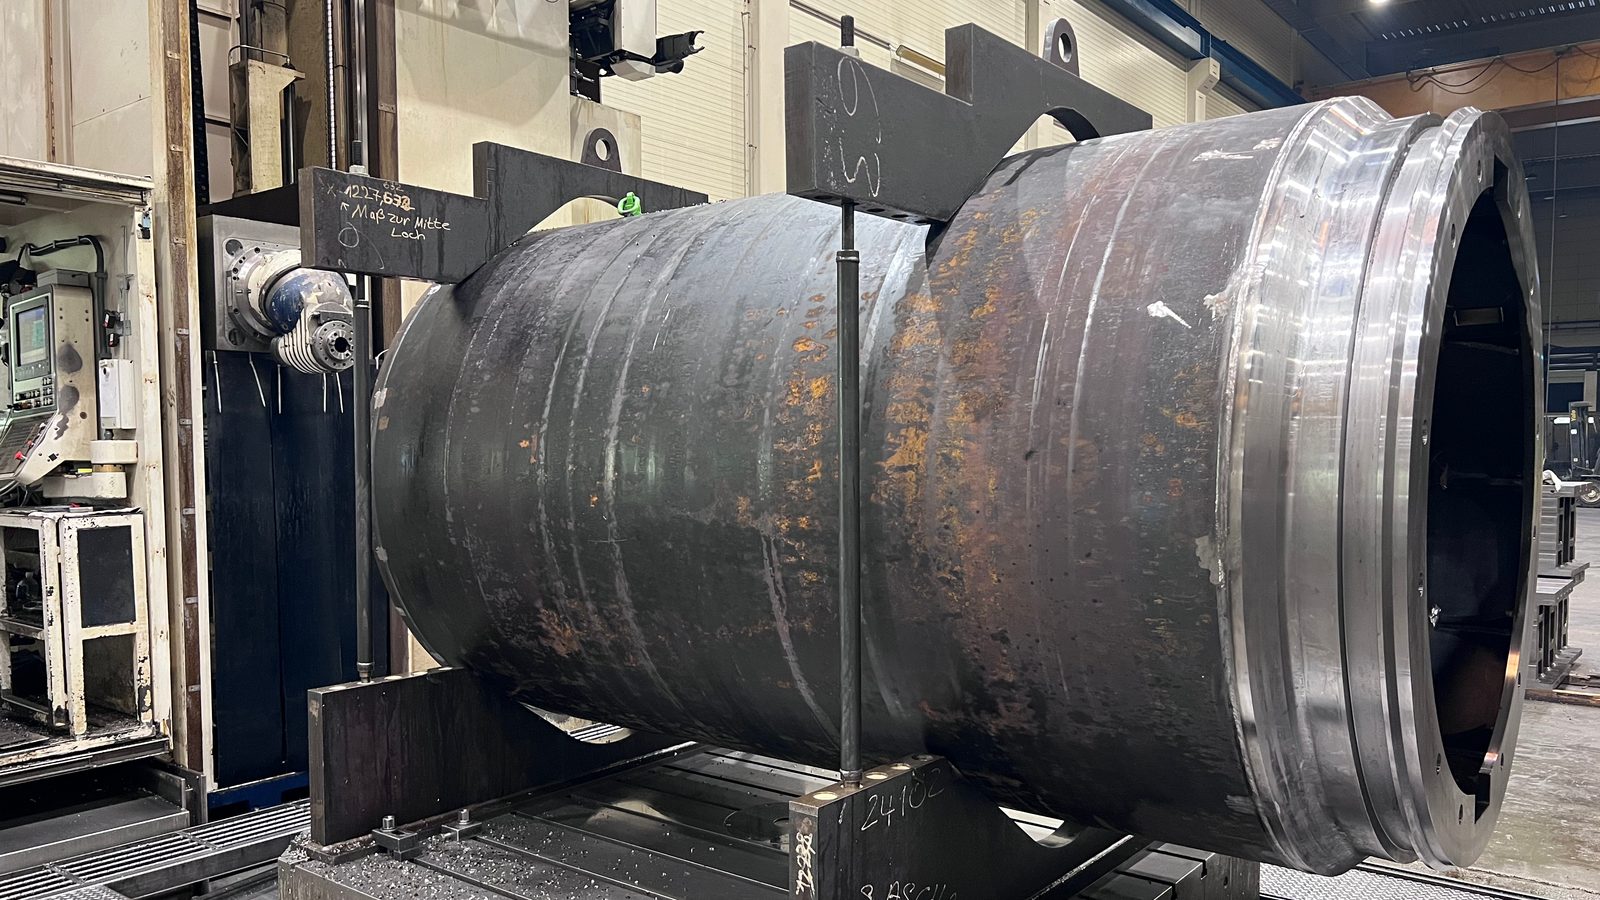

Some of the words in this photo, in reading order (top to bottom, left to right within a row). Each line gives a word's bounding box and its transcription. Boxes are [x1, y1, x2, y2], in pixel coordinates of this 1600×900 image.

[351, 204, 386, 225] Maß
[389, 213, 410, 226] zur
[414, 217, 451, 231] Mitte
[391, 228, 426, 241] Loch
